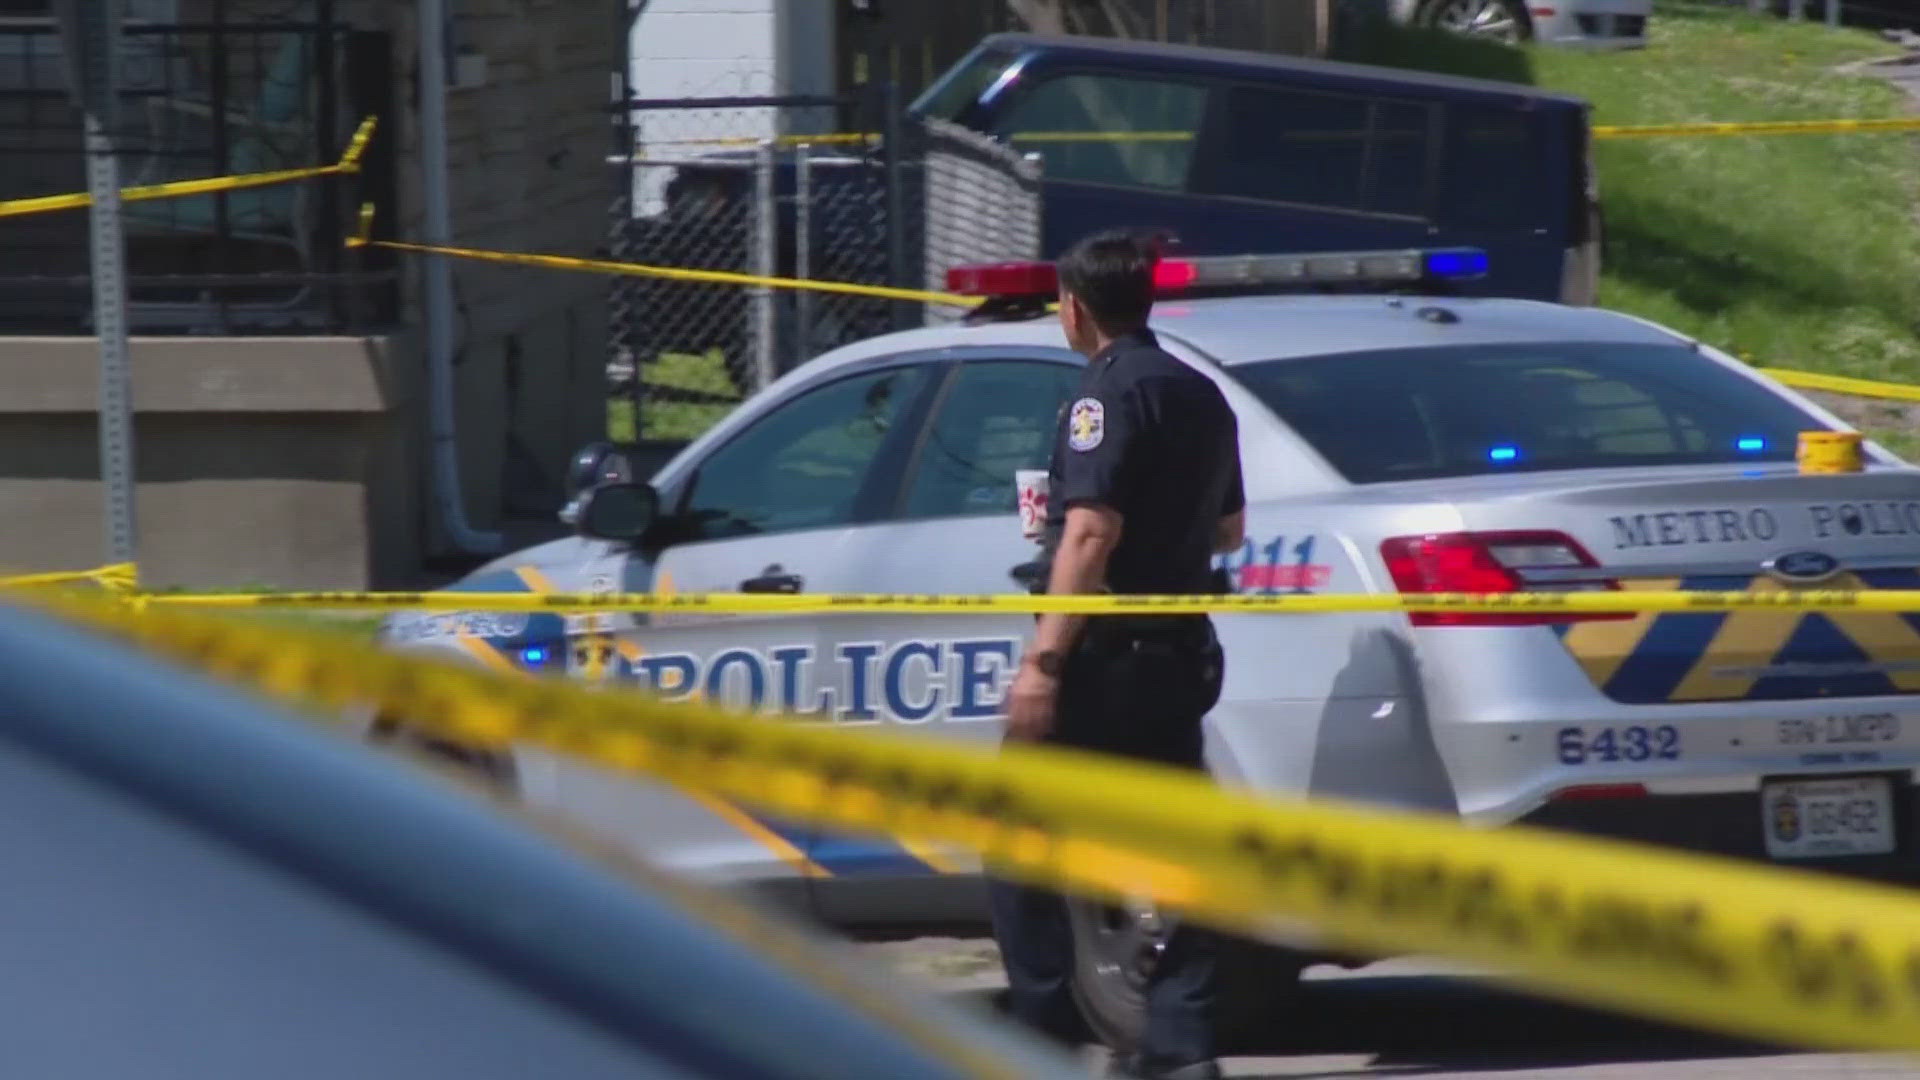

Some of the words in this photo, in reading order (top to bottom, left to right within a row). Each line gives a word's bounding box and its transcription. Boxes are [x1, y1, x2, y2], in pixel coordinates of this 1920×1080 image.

[1609, 508, 1777, 549] METRO
[636, 637, 1020, 723] POLICE
[1558, 725, 1682, 766] 6432
